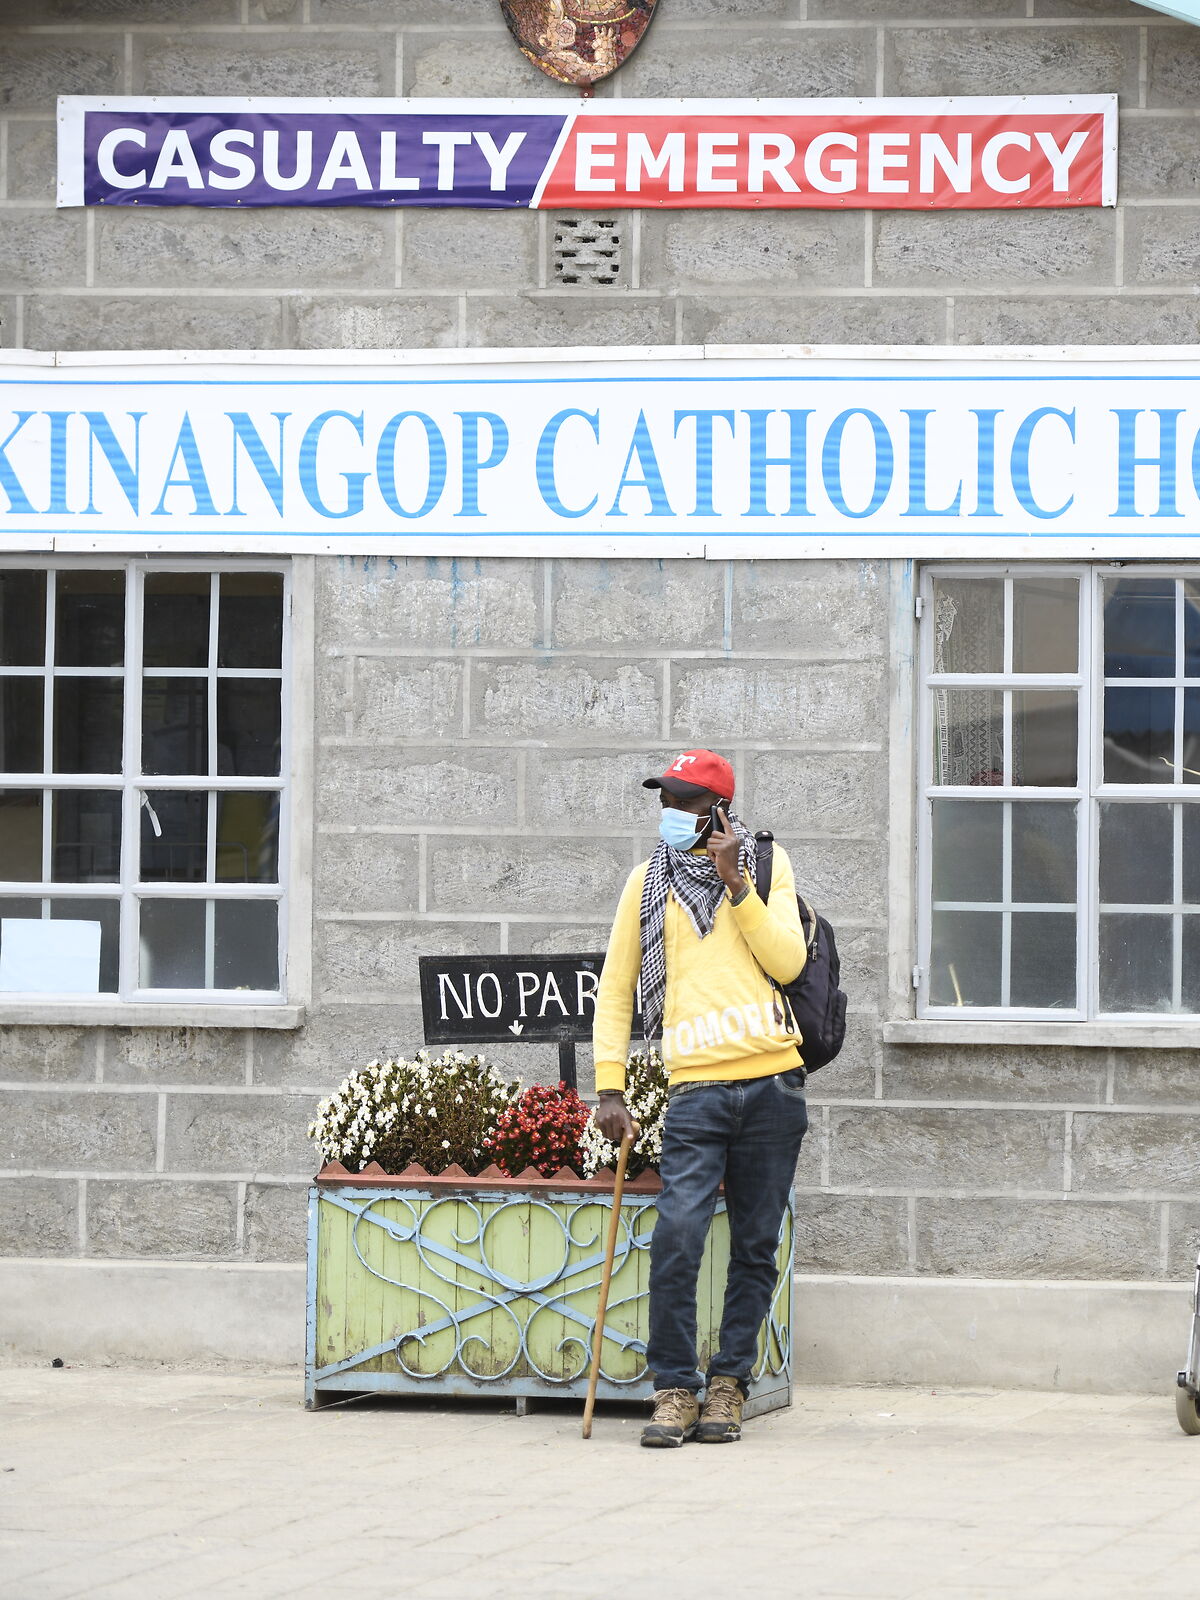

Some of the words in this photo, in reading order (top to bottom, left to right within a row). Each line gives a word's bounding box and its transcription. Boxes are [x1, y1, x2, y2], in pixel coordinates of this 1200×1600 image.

[98, 128, 527, 192] CASUALTY
[575, 131, 1090, 194] EMERGENCY
[536, 407, 1076, 520] CATHOLIC
[672, 754, 697, 771] T
[437, 972, 503, 1020] NO
